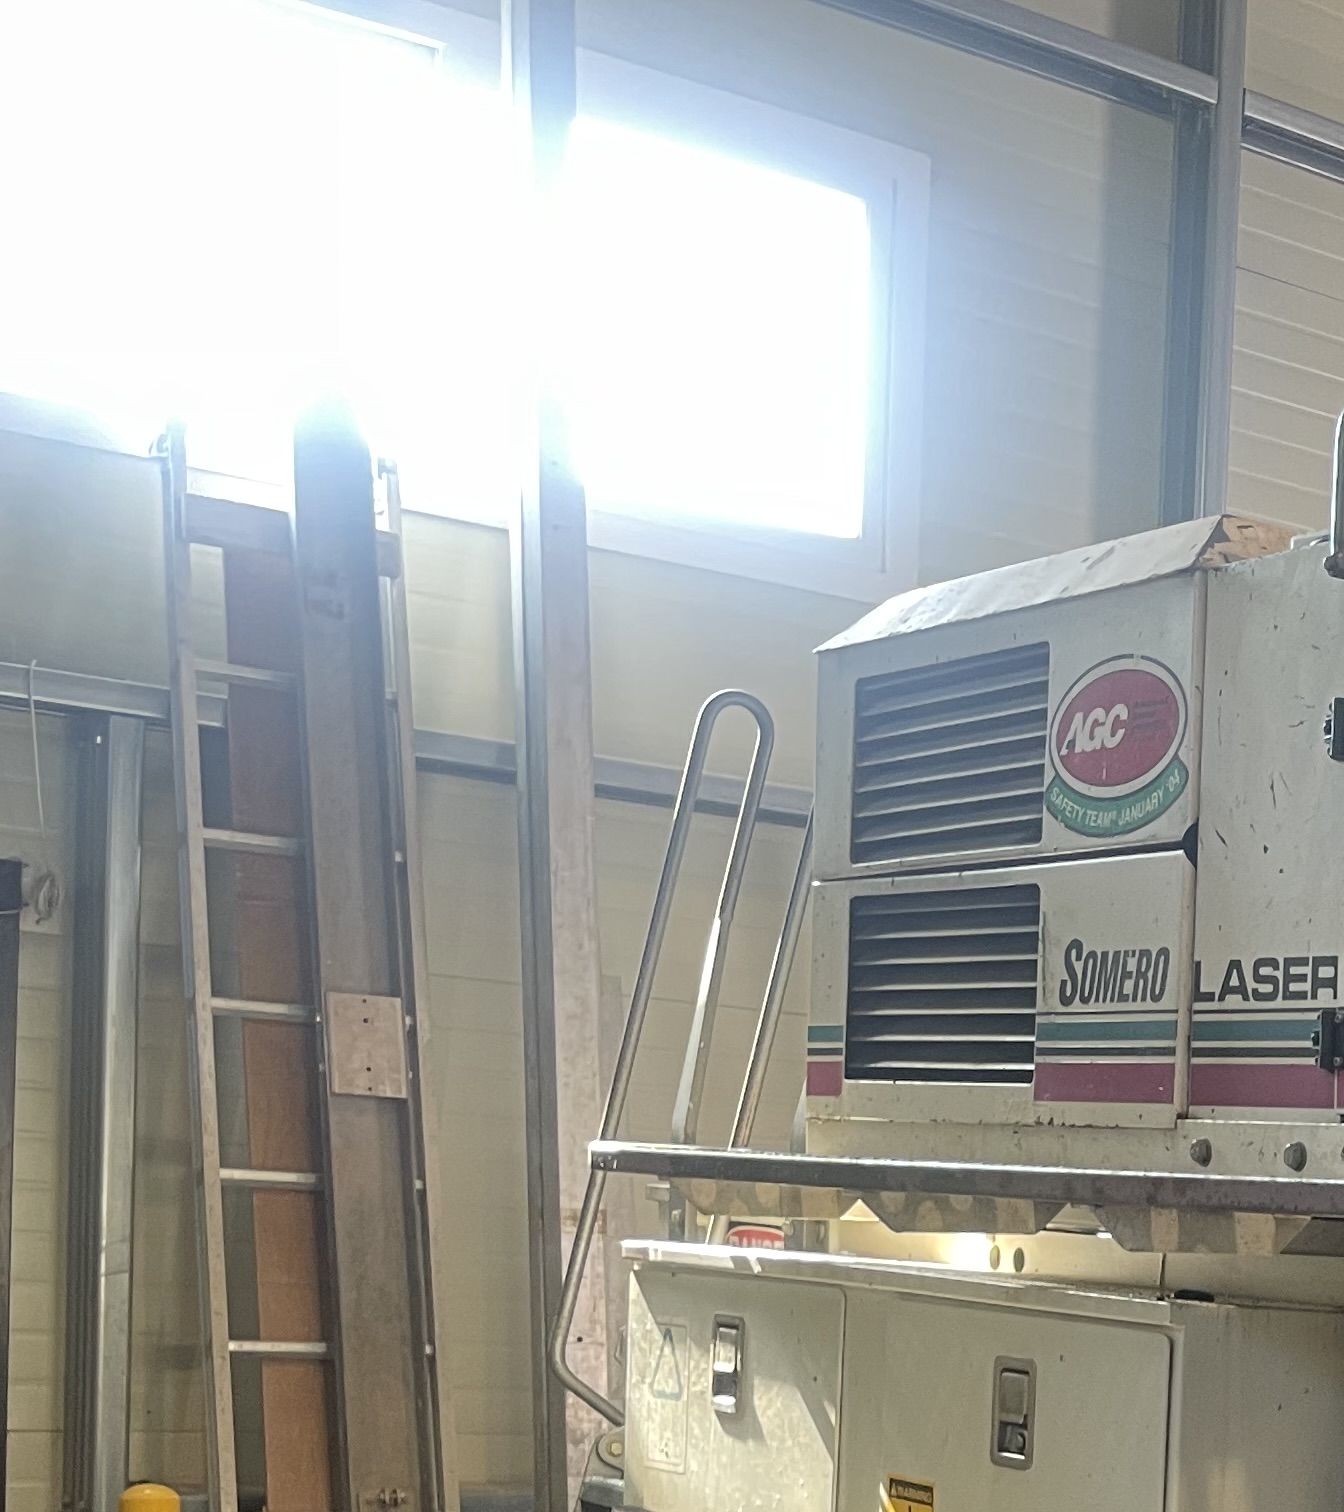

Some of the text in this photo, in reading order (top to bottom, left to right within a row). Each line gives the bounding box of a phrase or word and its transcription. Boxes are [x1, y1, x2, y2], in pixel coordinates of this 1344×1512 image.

[1059, 703, 1129, 756] AGC
[1050, 786, 1086, 822] SAFETY
[1117, 786, 1165, 825] JANUARY
[1060, 938, 1170, 1007] SOMERO
